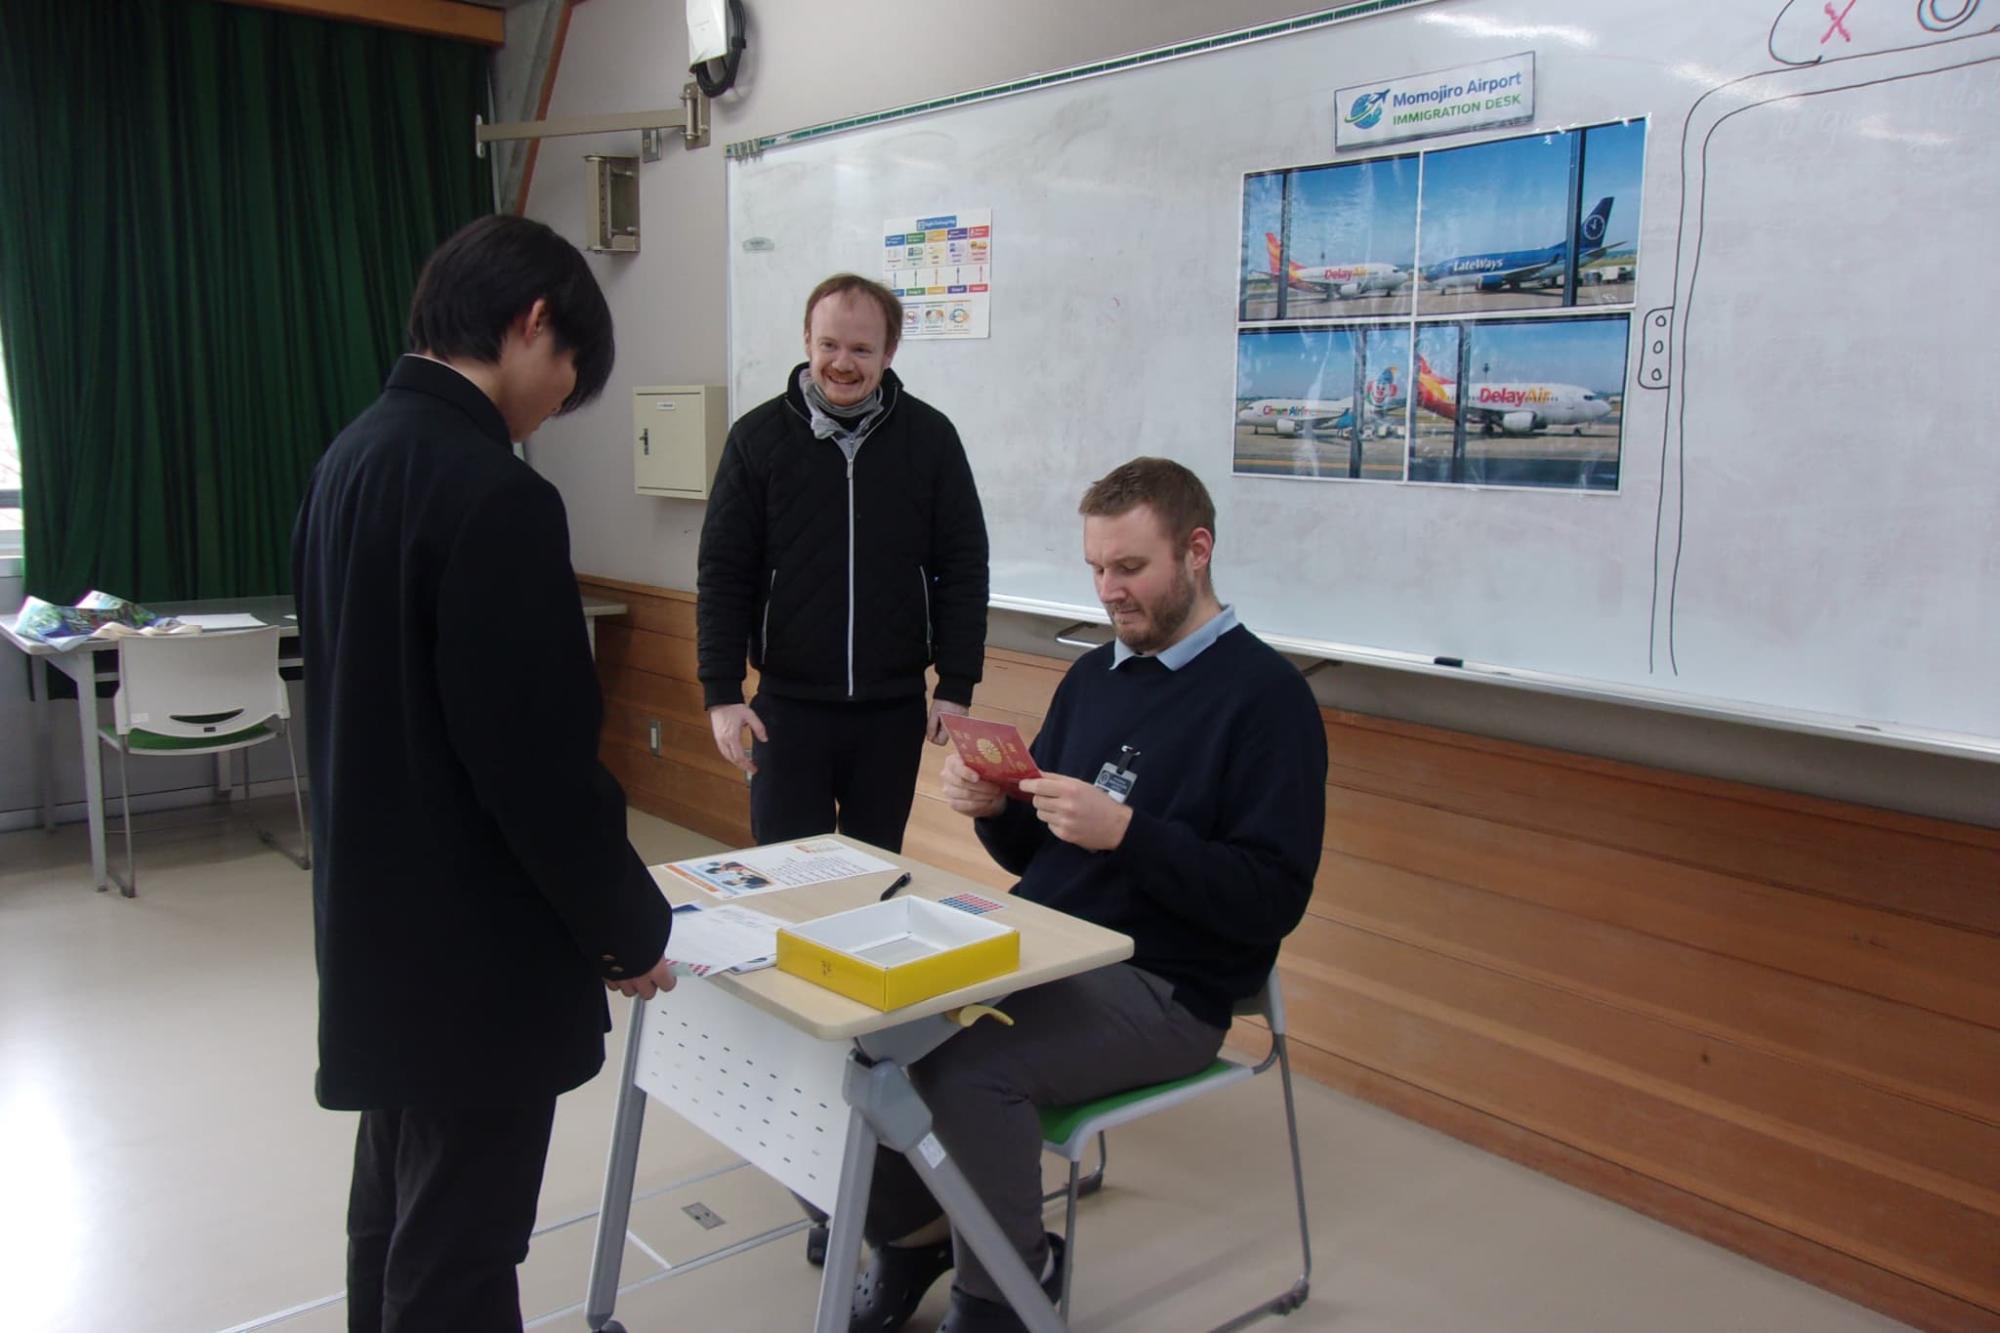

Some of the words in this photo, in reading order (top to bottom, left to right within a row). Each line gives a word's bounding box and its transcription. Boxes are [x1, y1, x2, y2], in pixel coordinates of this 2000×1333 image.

[1392, 85, 1463, 107] Momojiro
[1467, 72, 1522, 93] Airport
[1393, 102, 1481, 125] IMMIGRATION
[1485, 94, 1521, 110] DESK
[1453, 257, 1504, 271] LateWays
[1480, 387, 1552, 407] DelayAir
